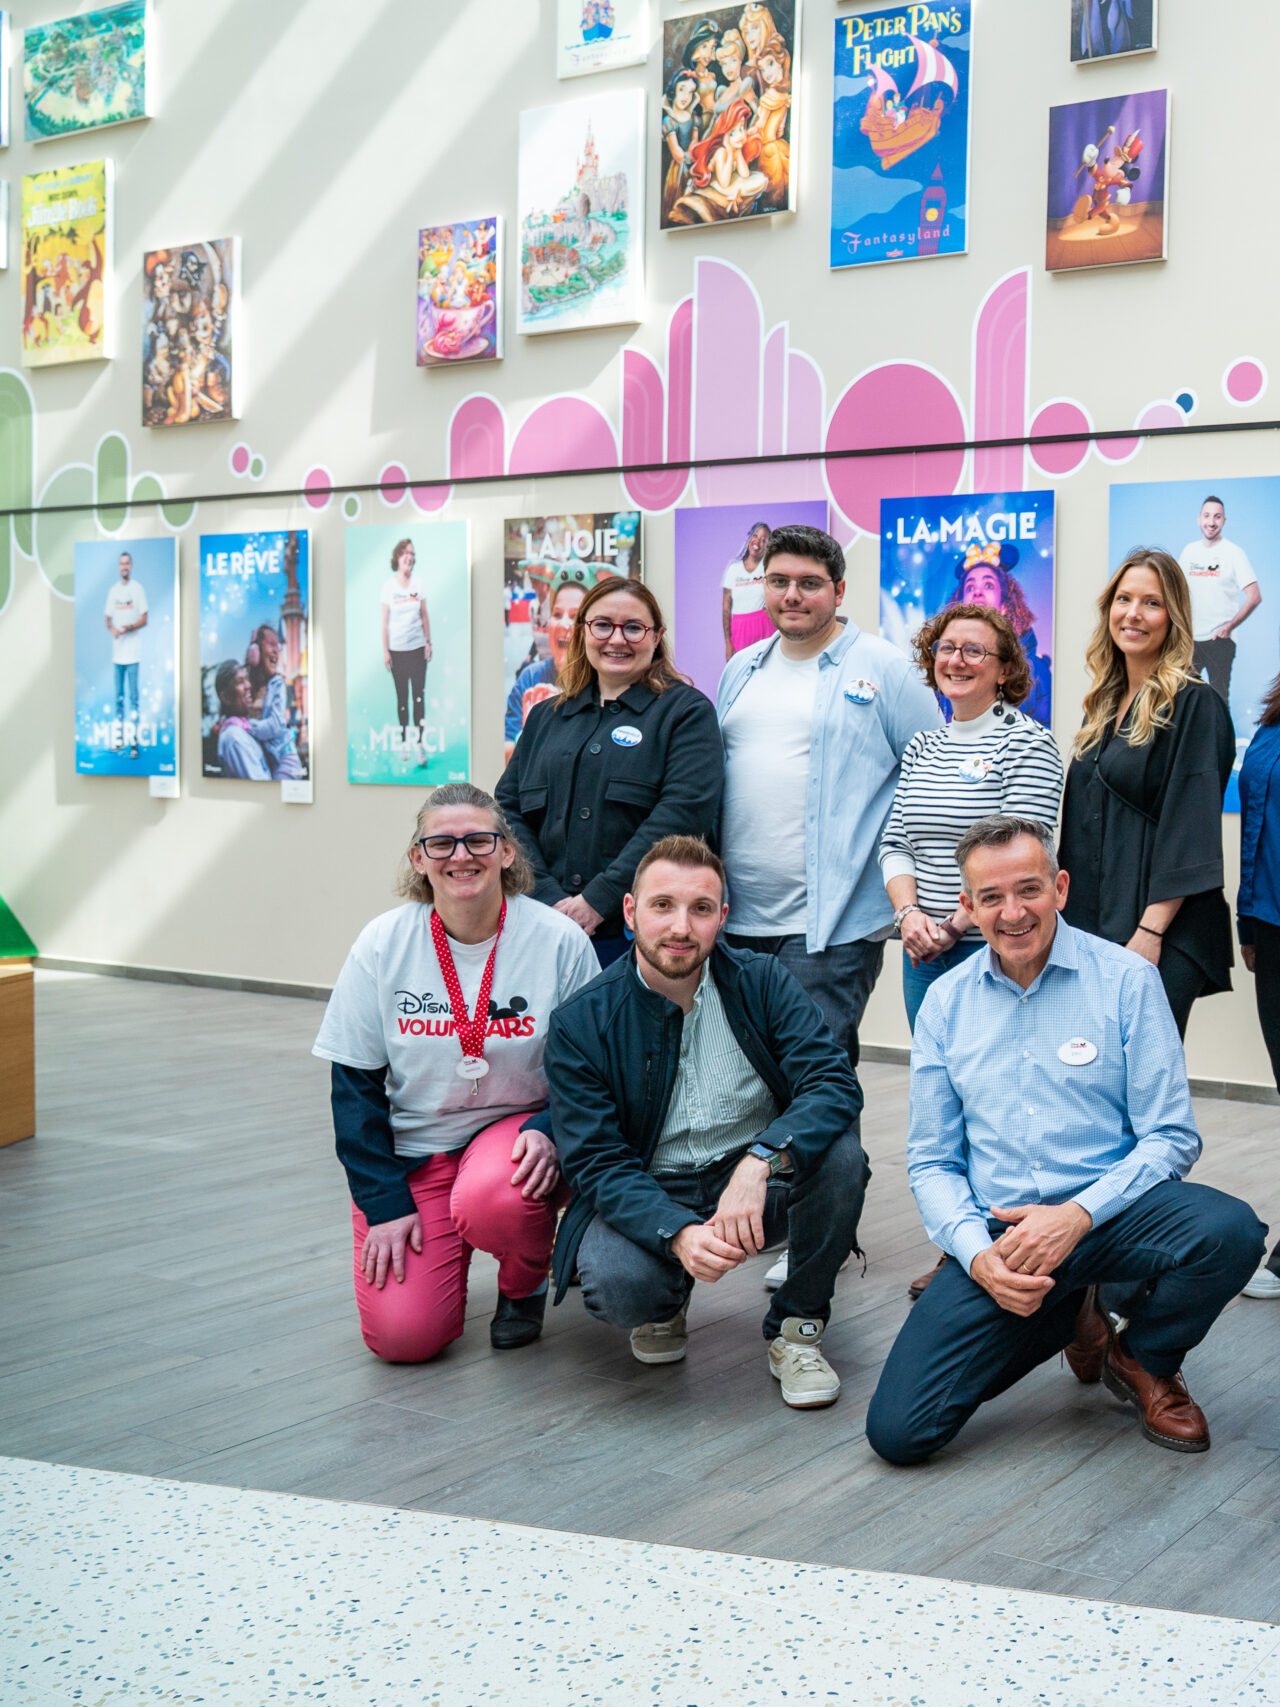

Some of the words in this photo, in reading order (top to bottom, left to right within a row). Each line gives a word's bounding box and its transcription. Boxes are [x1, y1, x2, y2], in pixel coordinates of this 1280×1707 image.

[842, 16, 908, 49] PETER
[852, 44, 917, 76] FLIGHT
[841, 224, 951, 255] Fantasyland
[526, 533, 556, 560] LA
[561, 528, 619, 559] JOIE
[897, 517, 933, 544] LA
[940, 512, 1037, 543] MAGIE
[206, 553, 228, 576] LE
[230, 543, 280, 575] RÊVE
[94, 720, 157, 749] MERCI
[370, 726, 445, 752] MERCI
